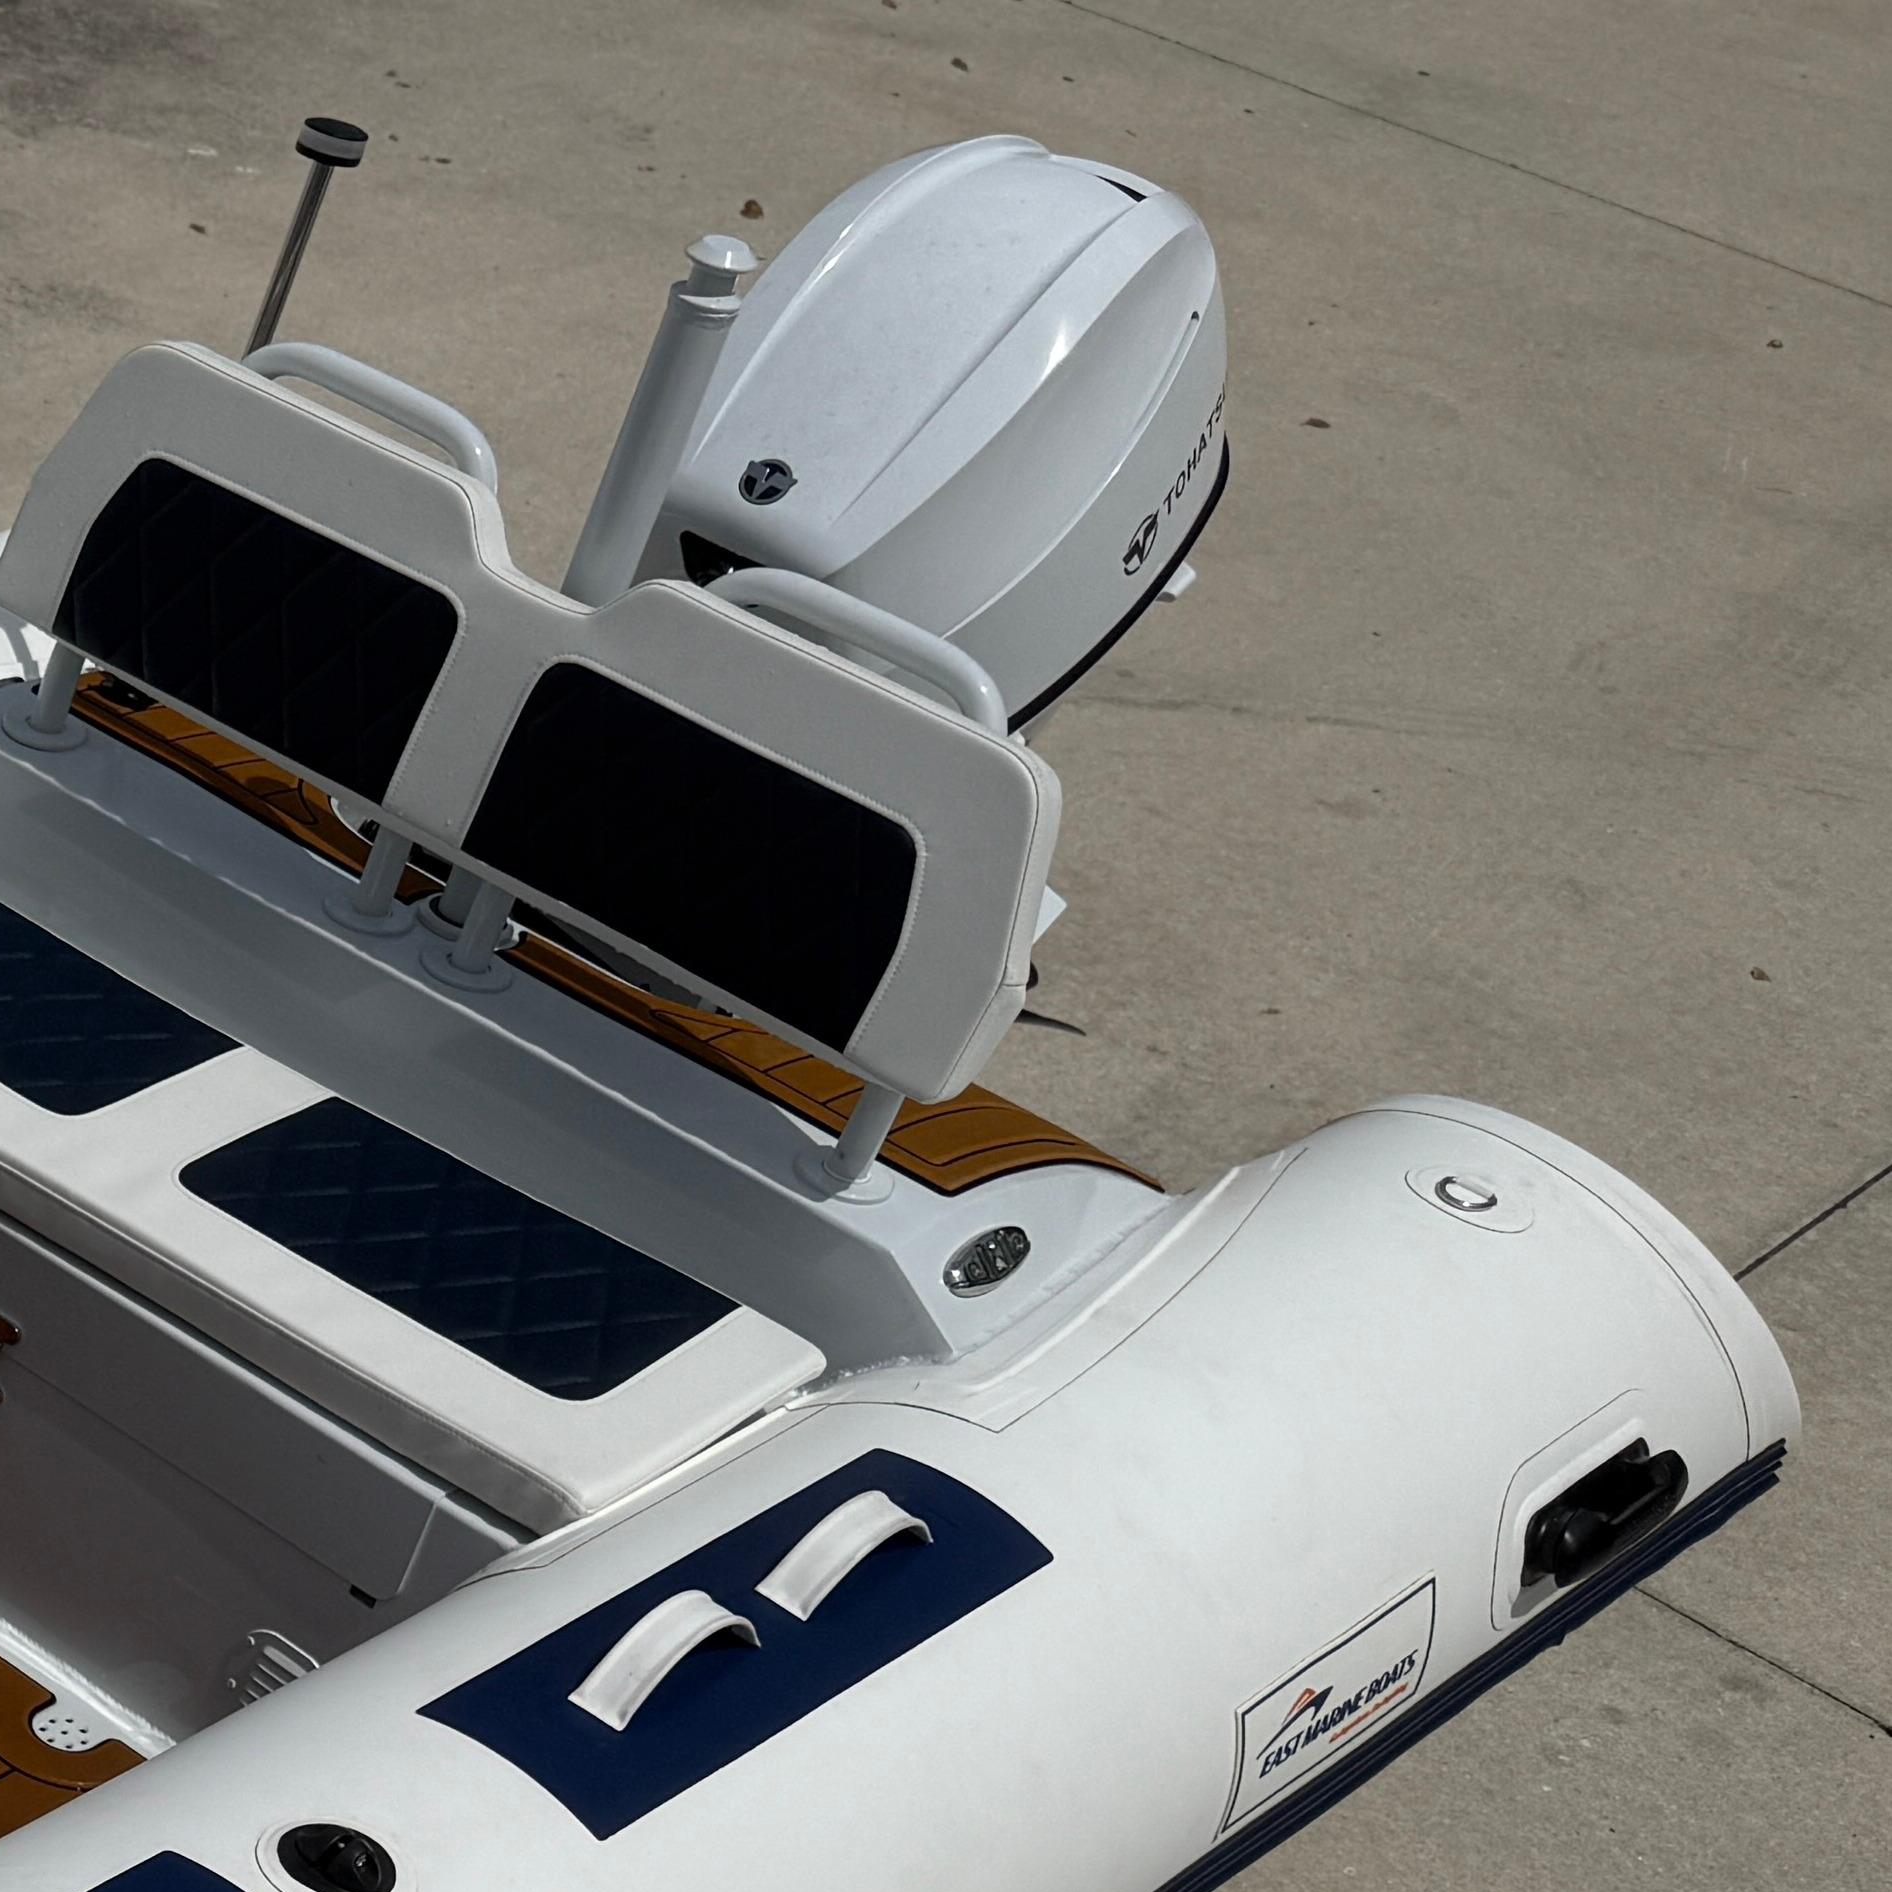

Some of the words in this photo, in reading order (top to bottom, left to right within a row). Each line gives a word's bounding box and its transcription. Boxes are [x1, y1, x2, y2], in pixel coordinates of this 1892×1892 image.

[1259, 1730, 1305, 1779] EAST
[1301, 1686, 1368, 1749] MARINE
[1365, 1649, 1419, 1705] BOATS
